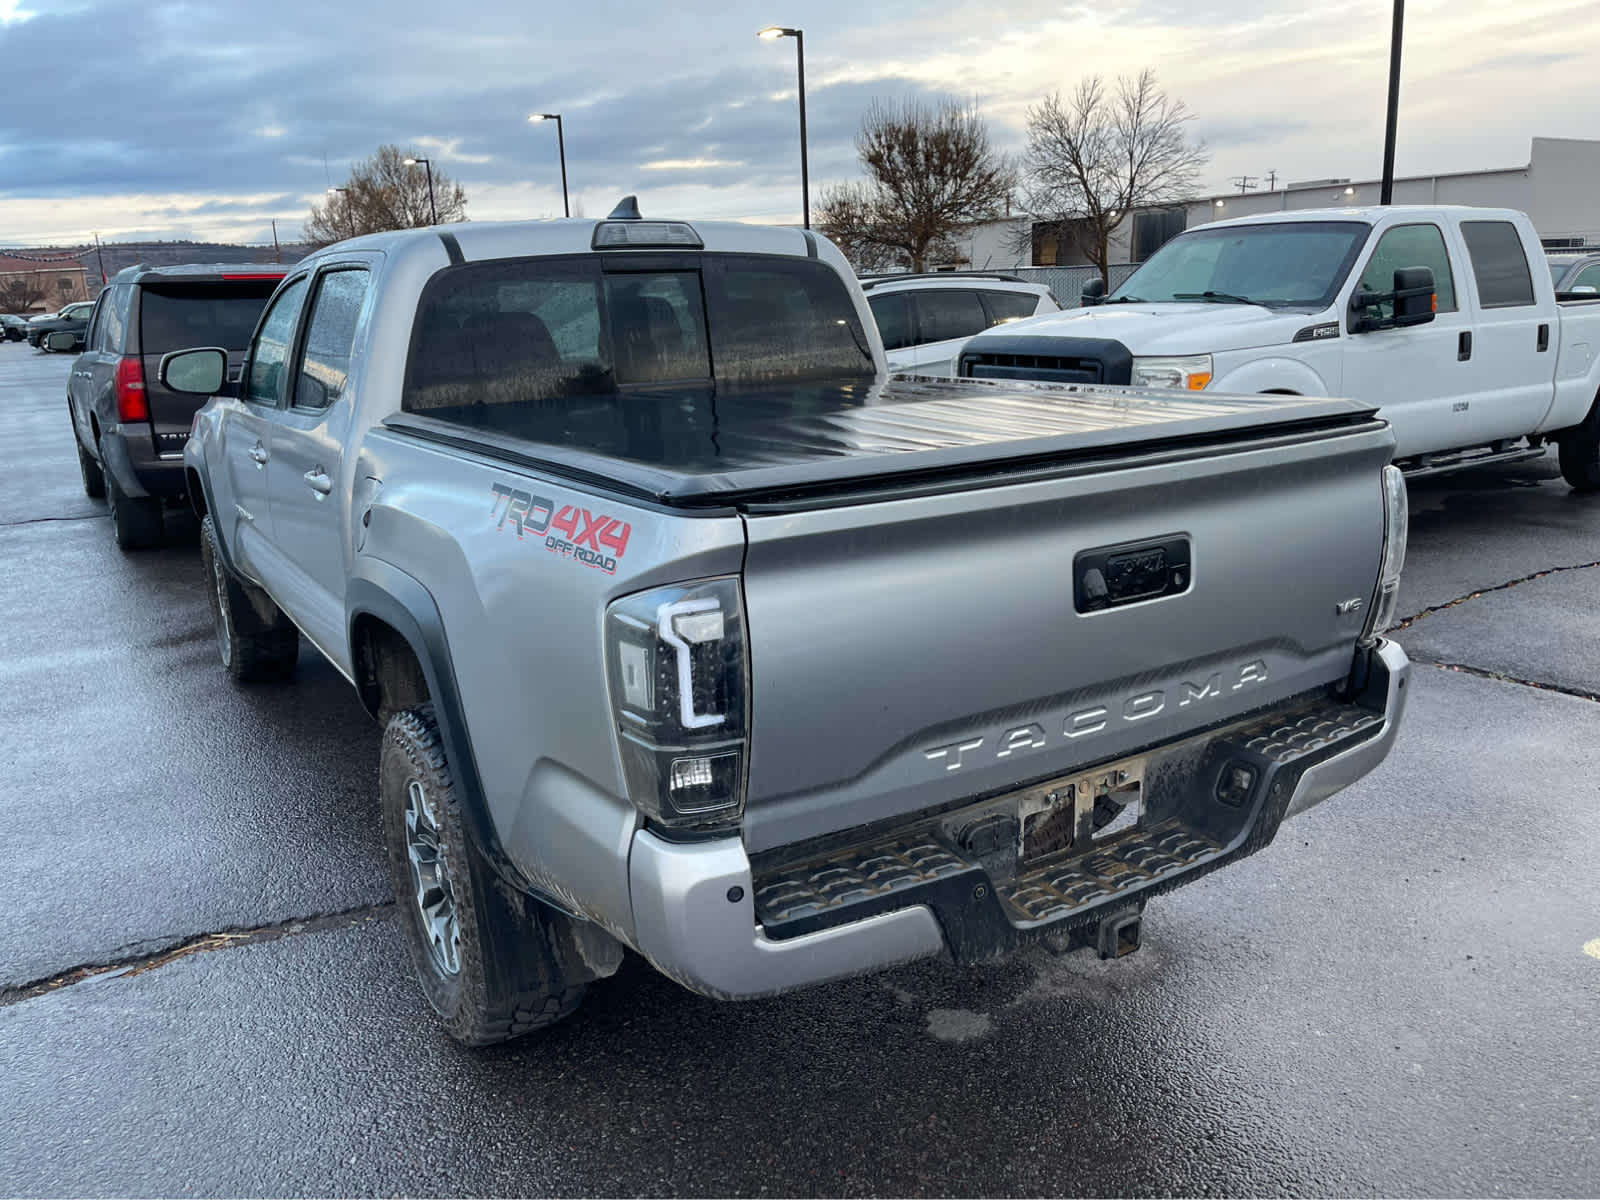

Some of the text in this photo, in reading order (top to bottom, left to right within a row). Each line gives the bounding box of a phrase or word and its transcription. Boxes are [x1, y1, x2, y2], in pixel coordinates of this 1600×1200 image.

[491, 482, 632, 558] TRD 4X4
[545, 535, 617, 574] OFF ROAD
[924, 658, 1270, 771] TACOMA
